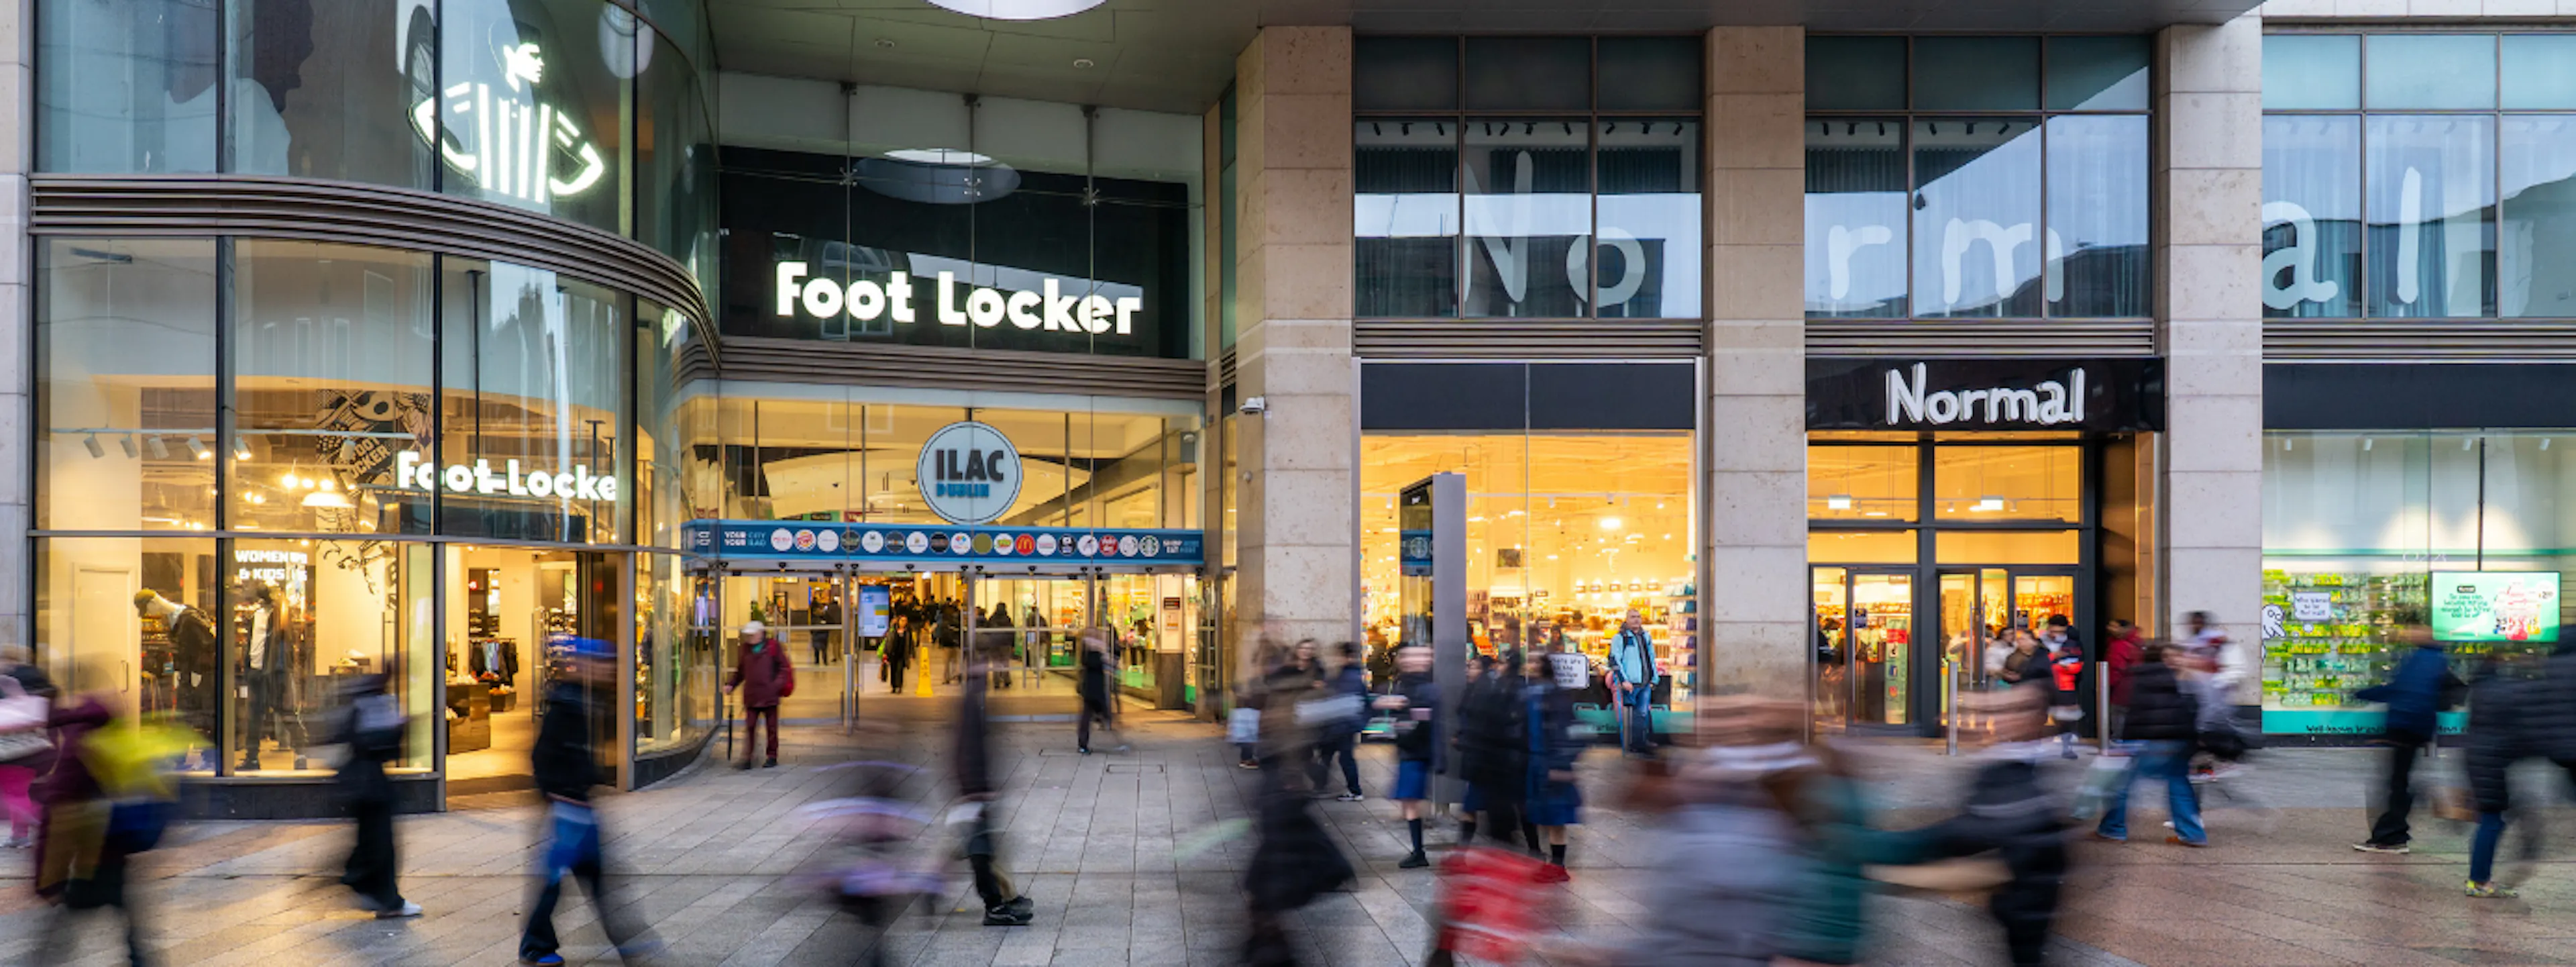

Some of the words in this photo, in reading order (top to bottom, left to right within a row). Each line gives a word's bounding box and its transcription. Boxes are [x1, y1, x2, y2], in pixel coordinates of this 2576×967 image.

[776, 260, 915, 323] Foot
[938, 270, 1140, 334] Locker
[1885, 362, 2085, 425] Normal
[397, 450, 494, 494] Foot
[506, 458, 616, 501] Locke
[936, 449, 1005, 482] ILAC
[936, 483, 989, 498] DUBLIN
